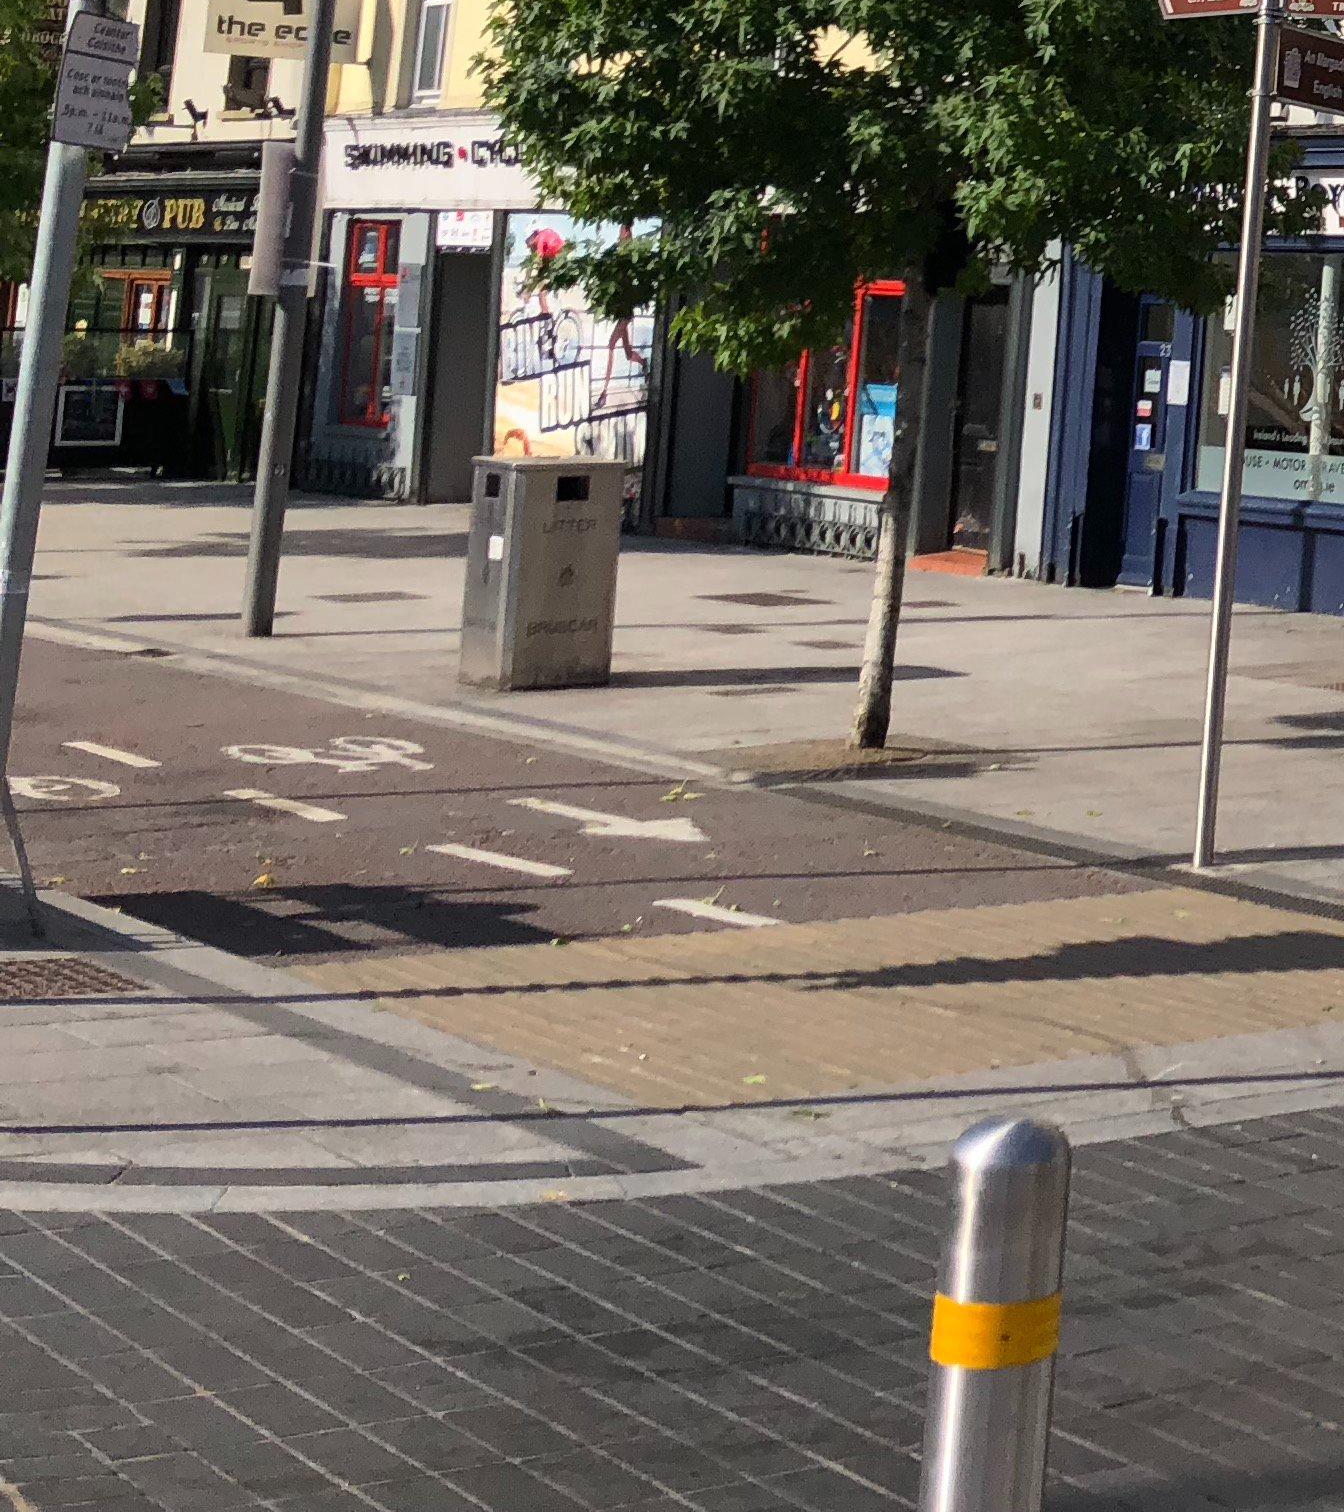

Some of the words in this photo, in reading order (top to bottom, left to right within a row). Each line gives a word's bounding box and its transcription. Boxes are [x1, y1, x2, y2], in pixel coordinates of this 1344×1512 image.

[217, 14, 266, 37] the
[163, 198, 206, 230] PUB
[540, 364, 591, 431] RUN
[1273, 459, 1306, 472] MOTOR
[542, 519, 597, 535] LITTER
